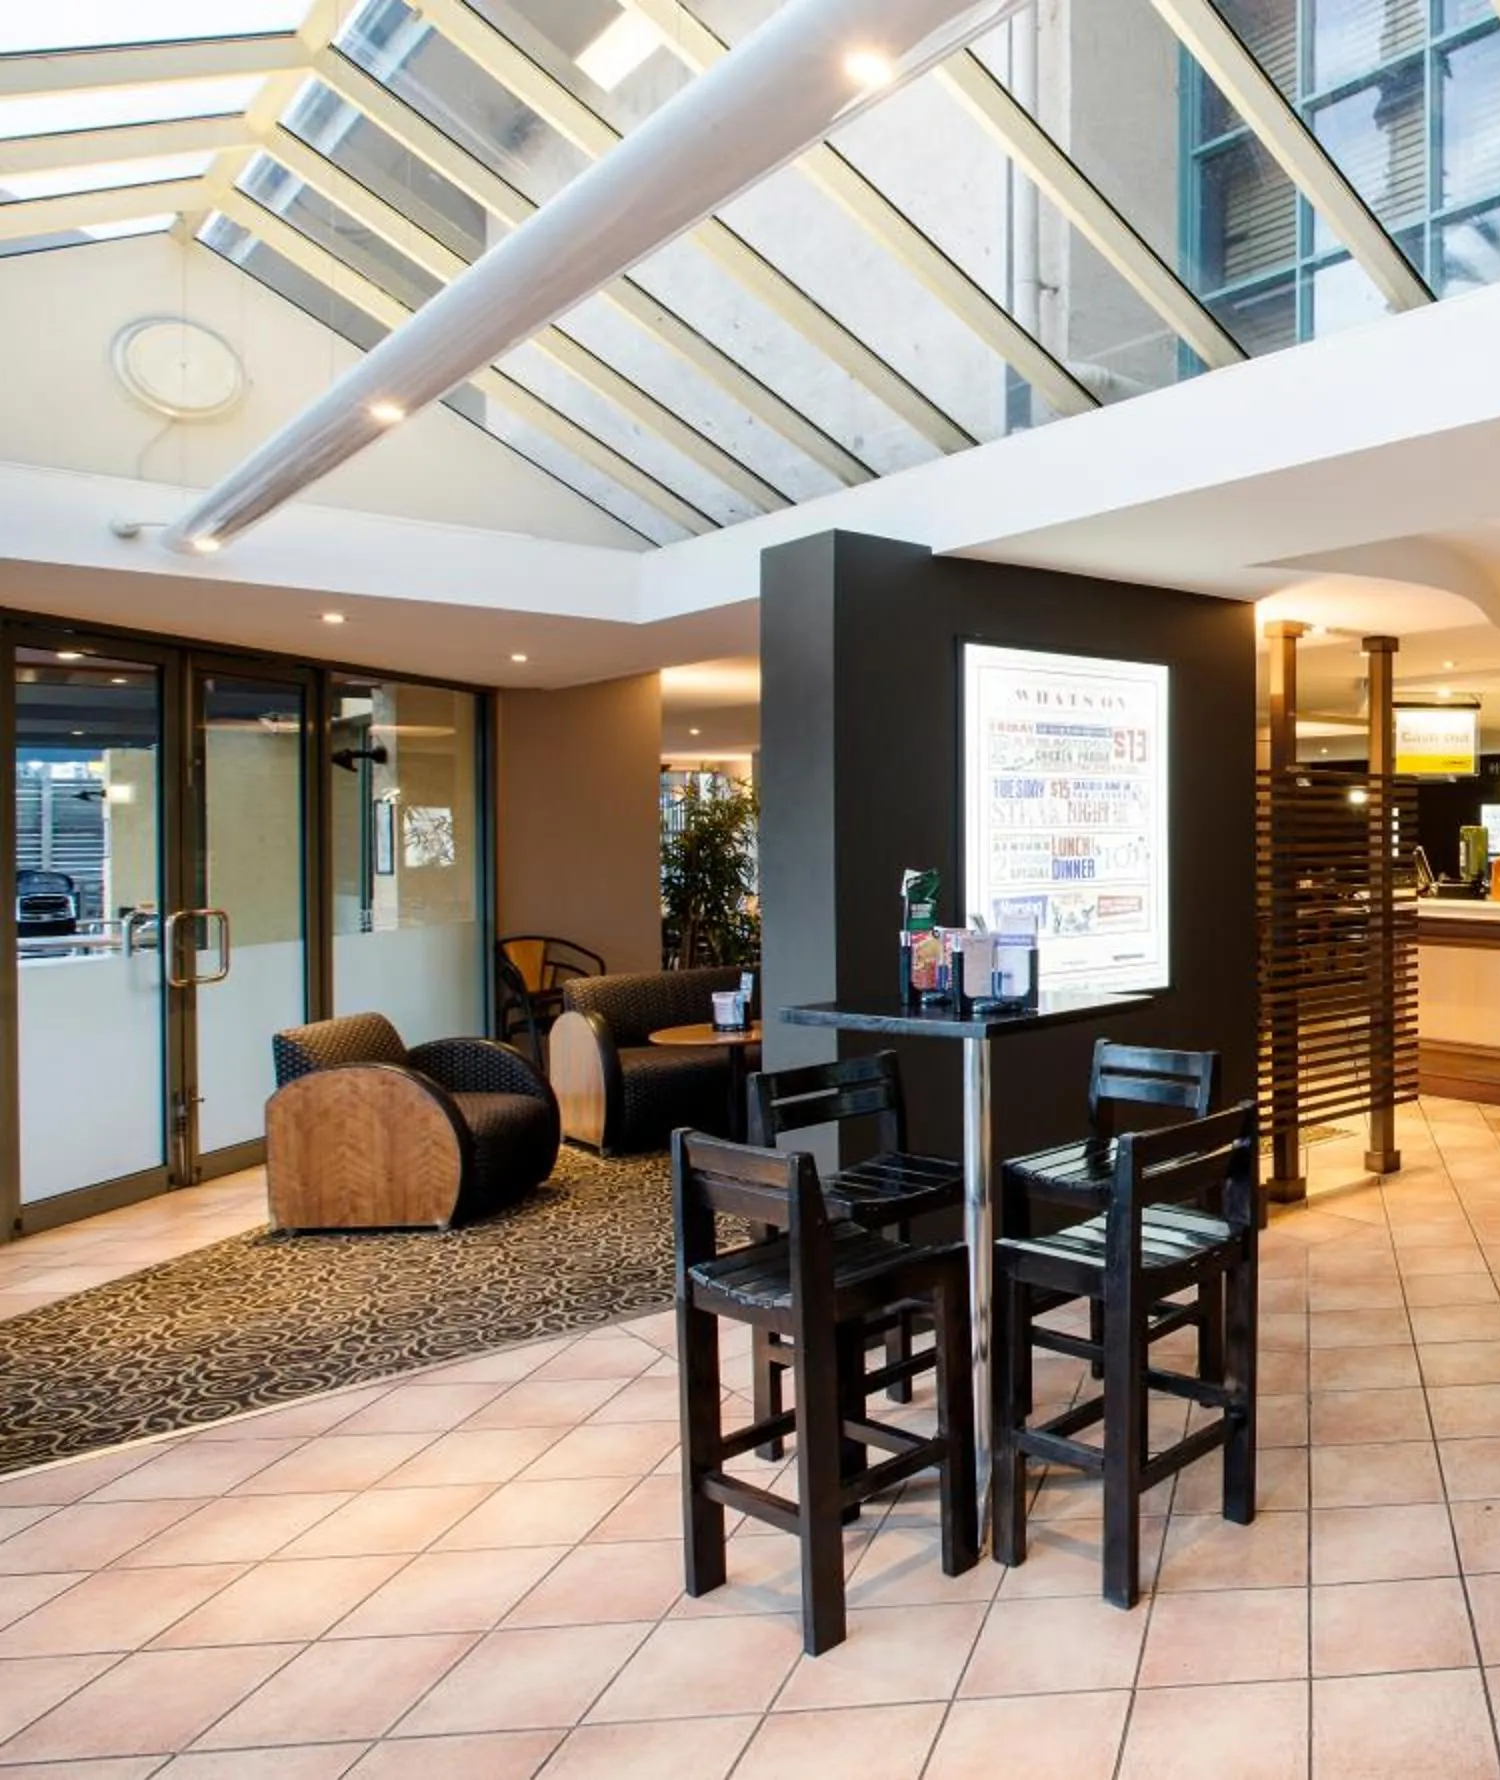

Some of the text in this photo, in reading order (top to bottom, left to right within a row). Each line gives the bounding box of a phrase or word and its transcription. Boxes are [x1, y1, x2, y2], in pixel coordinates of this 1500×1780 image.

[1113, 729, 1147, 763] $13
[993, 778, 1045, 799] TUESDAY
[1050, 778, 1070, 799] $15
[1067, 800, 1109, 824] NIGHT
[1051, 834, 1095, 857] LUNCH
[1051, 858, 1095, 881] DINNER
